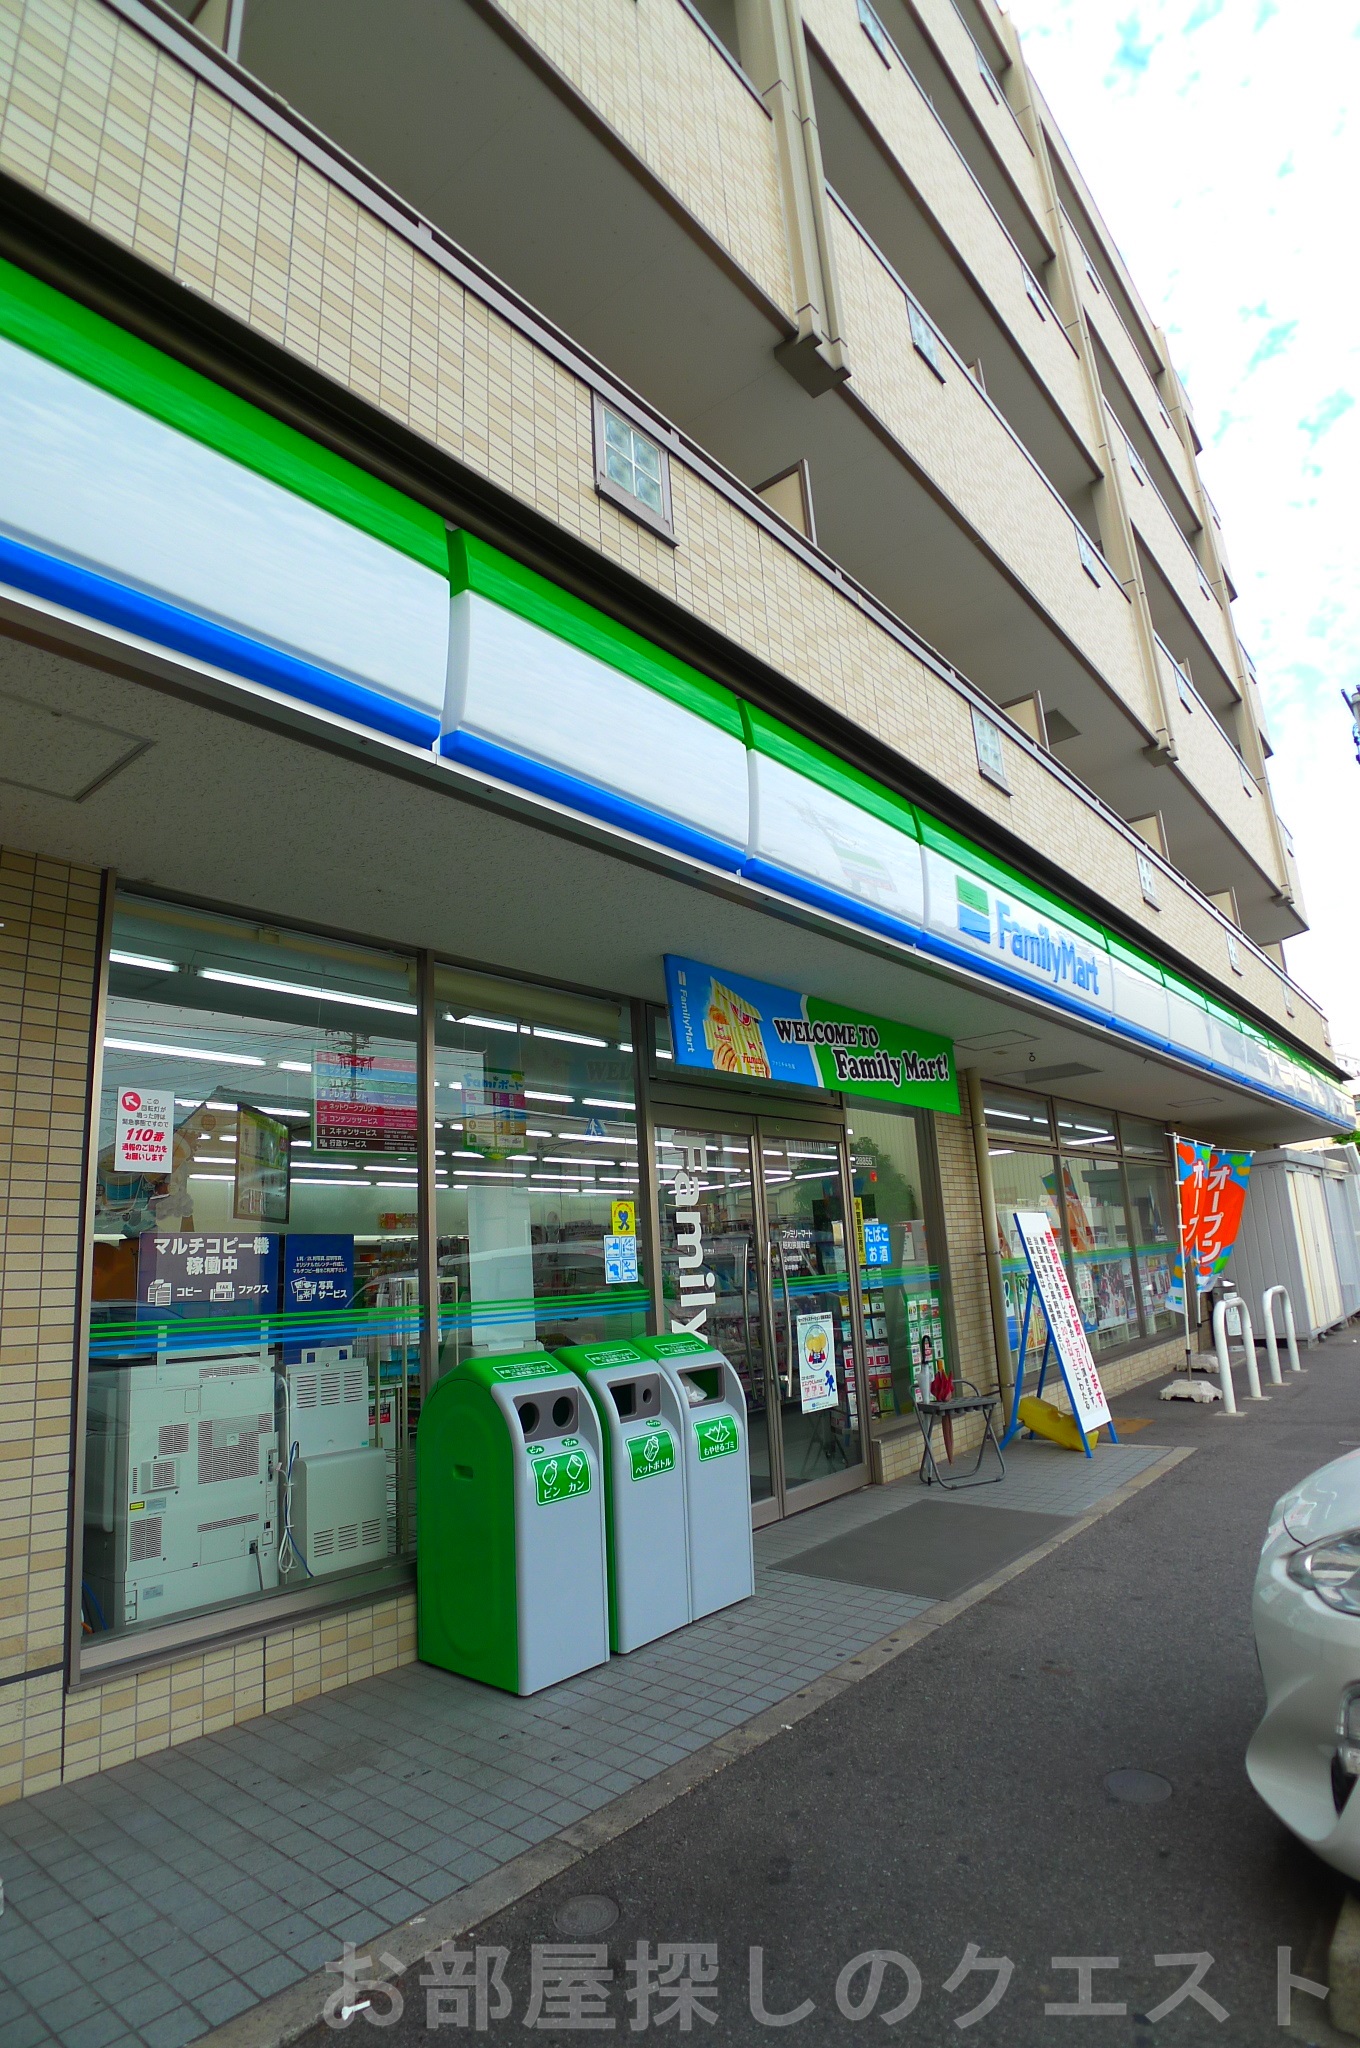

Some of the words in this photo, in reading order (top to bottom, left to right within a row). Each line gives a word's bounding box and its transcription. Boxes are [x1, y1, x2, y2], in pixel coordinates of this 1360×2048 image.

[995, 899, 1099, 996] FamilyMart
[680, 989, 695, 1053] FamilyMart
[773, 1018, 857, 1046] WELCOME
[858, 1025, 879, 1047] TO
[832, 1048, 901, 1086] Family
[902, 1051, 949, 1080] Mart!
[141, 1105, 167, 1113] 回転灯が
[126, 1127, 165, 1142] 110番
[121, 1142, 168, 1153] 通報のご協力を
[124, 1152, 165, 1162] お願いします
[1186, 1160, 1204, 1254] オープ
[1201, 1166, 1230, 1263] オープン
[782, 1229, 813, 1239] ファミリーマート
[865, 1226, 889, 1243] たばこ
[153, 1237, 270, 1255] マルチコピー機
[869, 1245, 889, 1262] お酒
[186, 1256, 238, 1275] 稼働中
[176, 1286, 203, 1297] コピー
[238, 1284, 269, 1295] ファクス
[318, 1280, 334, 1290] 写真
[318, 1289, 347, 1299] サービス
[703, 1441, 735, 1456] もやせるゴミ
[635, 1458, 672, 1475] ペットボトル
[544, 1487, 561, 1499] ビン
[568, 1481, 585, 1493] カン
